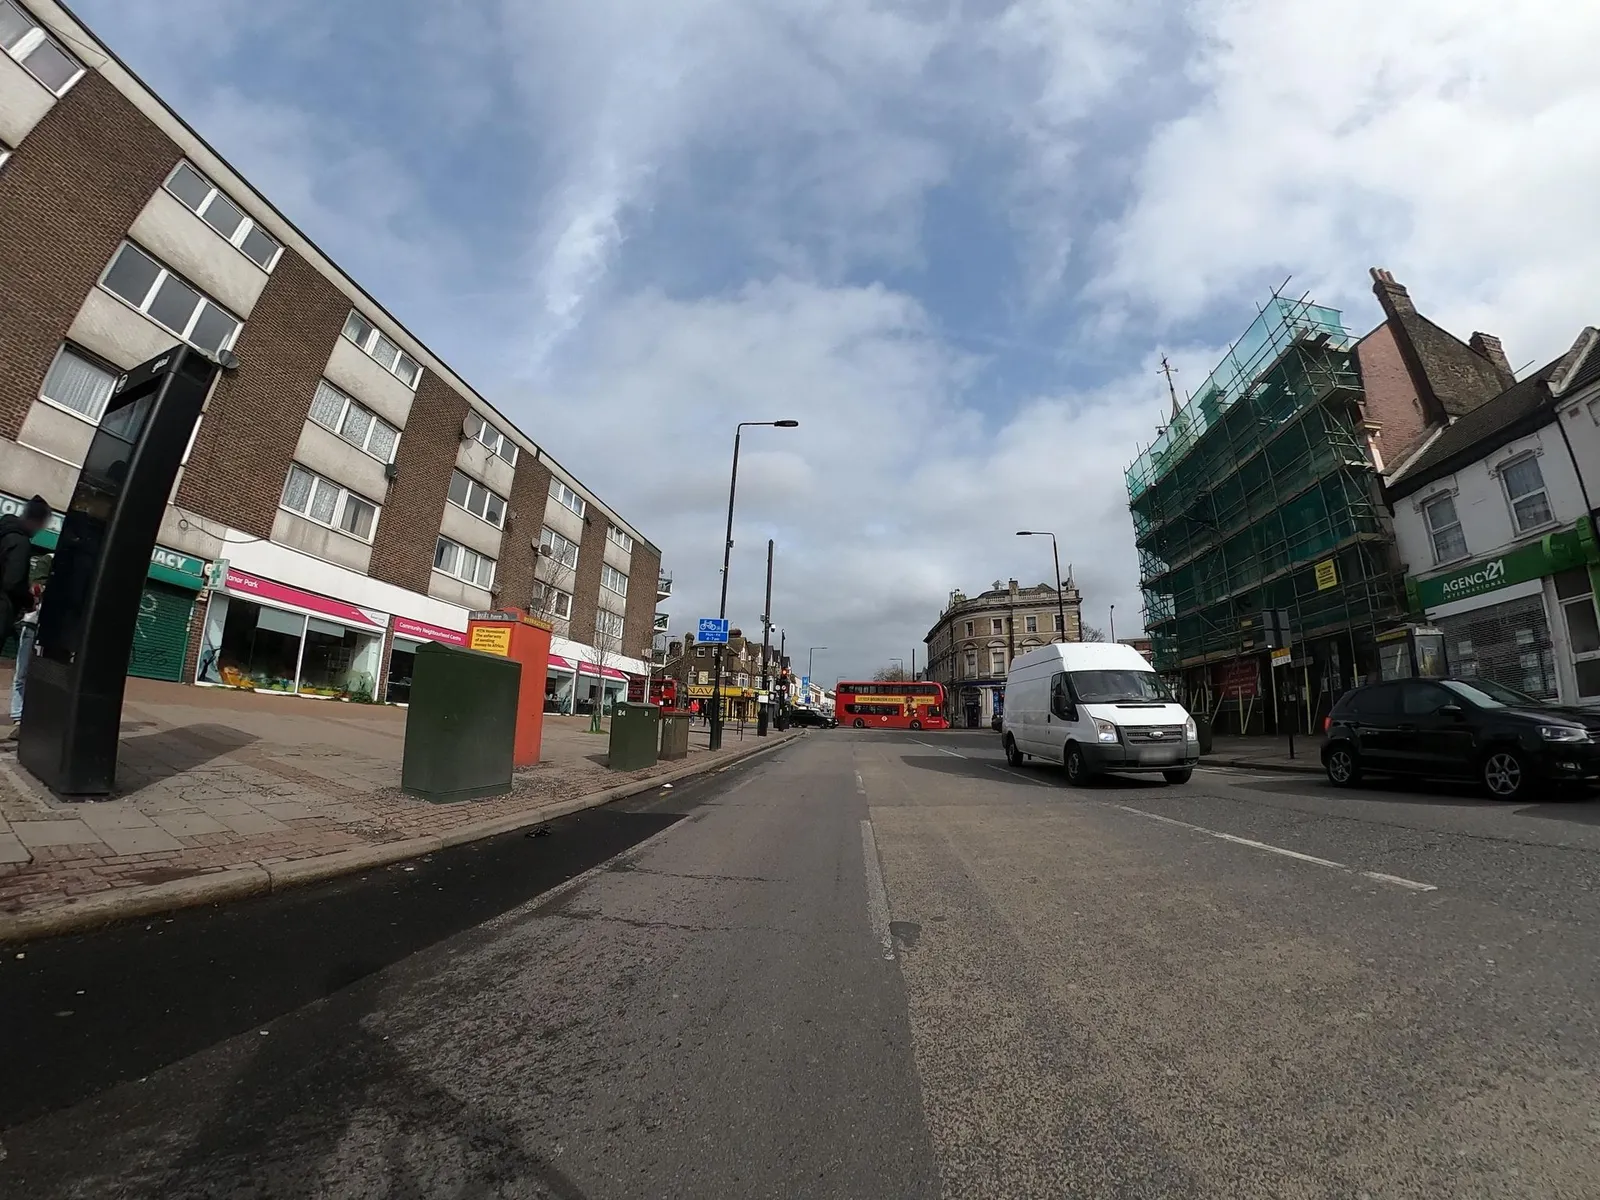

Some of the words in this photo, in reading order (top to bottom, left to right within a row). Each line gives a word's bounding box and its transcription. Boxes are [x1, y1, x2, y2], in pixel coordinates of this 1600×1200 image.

[244, 578, 259, 589] Park
[1443, 578, 1507, 600] INTERNATIONAL
[399, 621, 422, 633] Community
[422, 627, 450, 639] Neighbourhood
